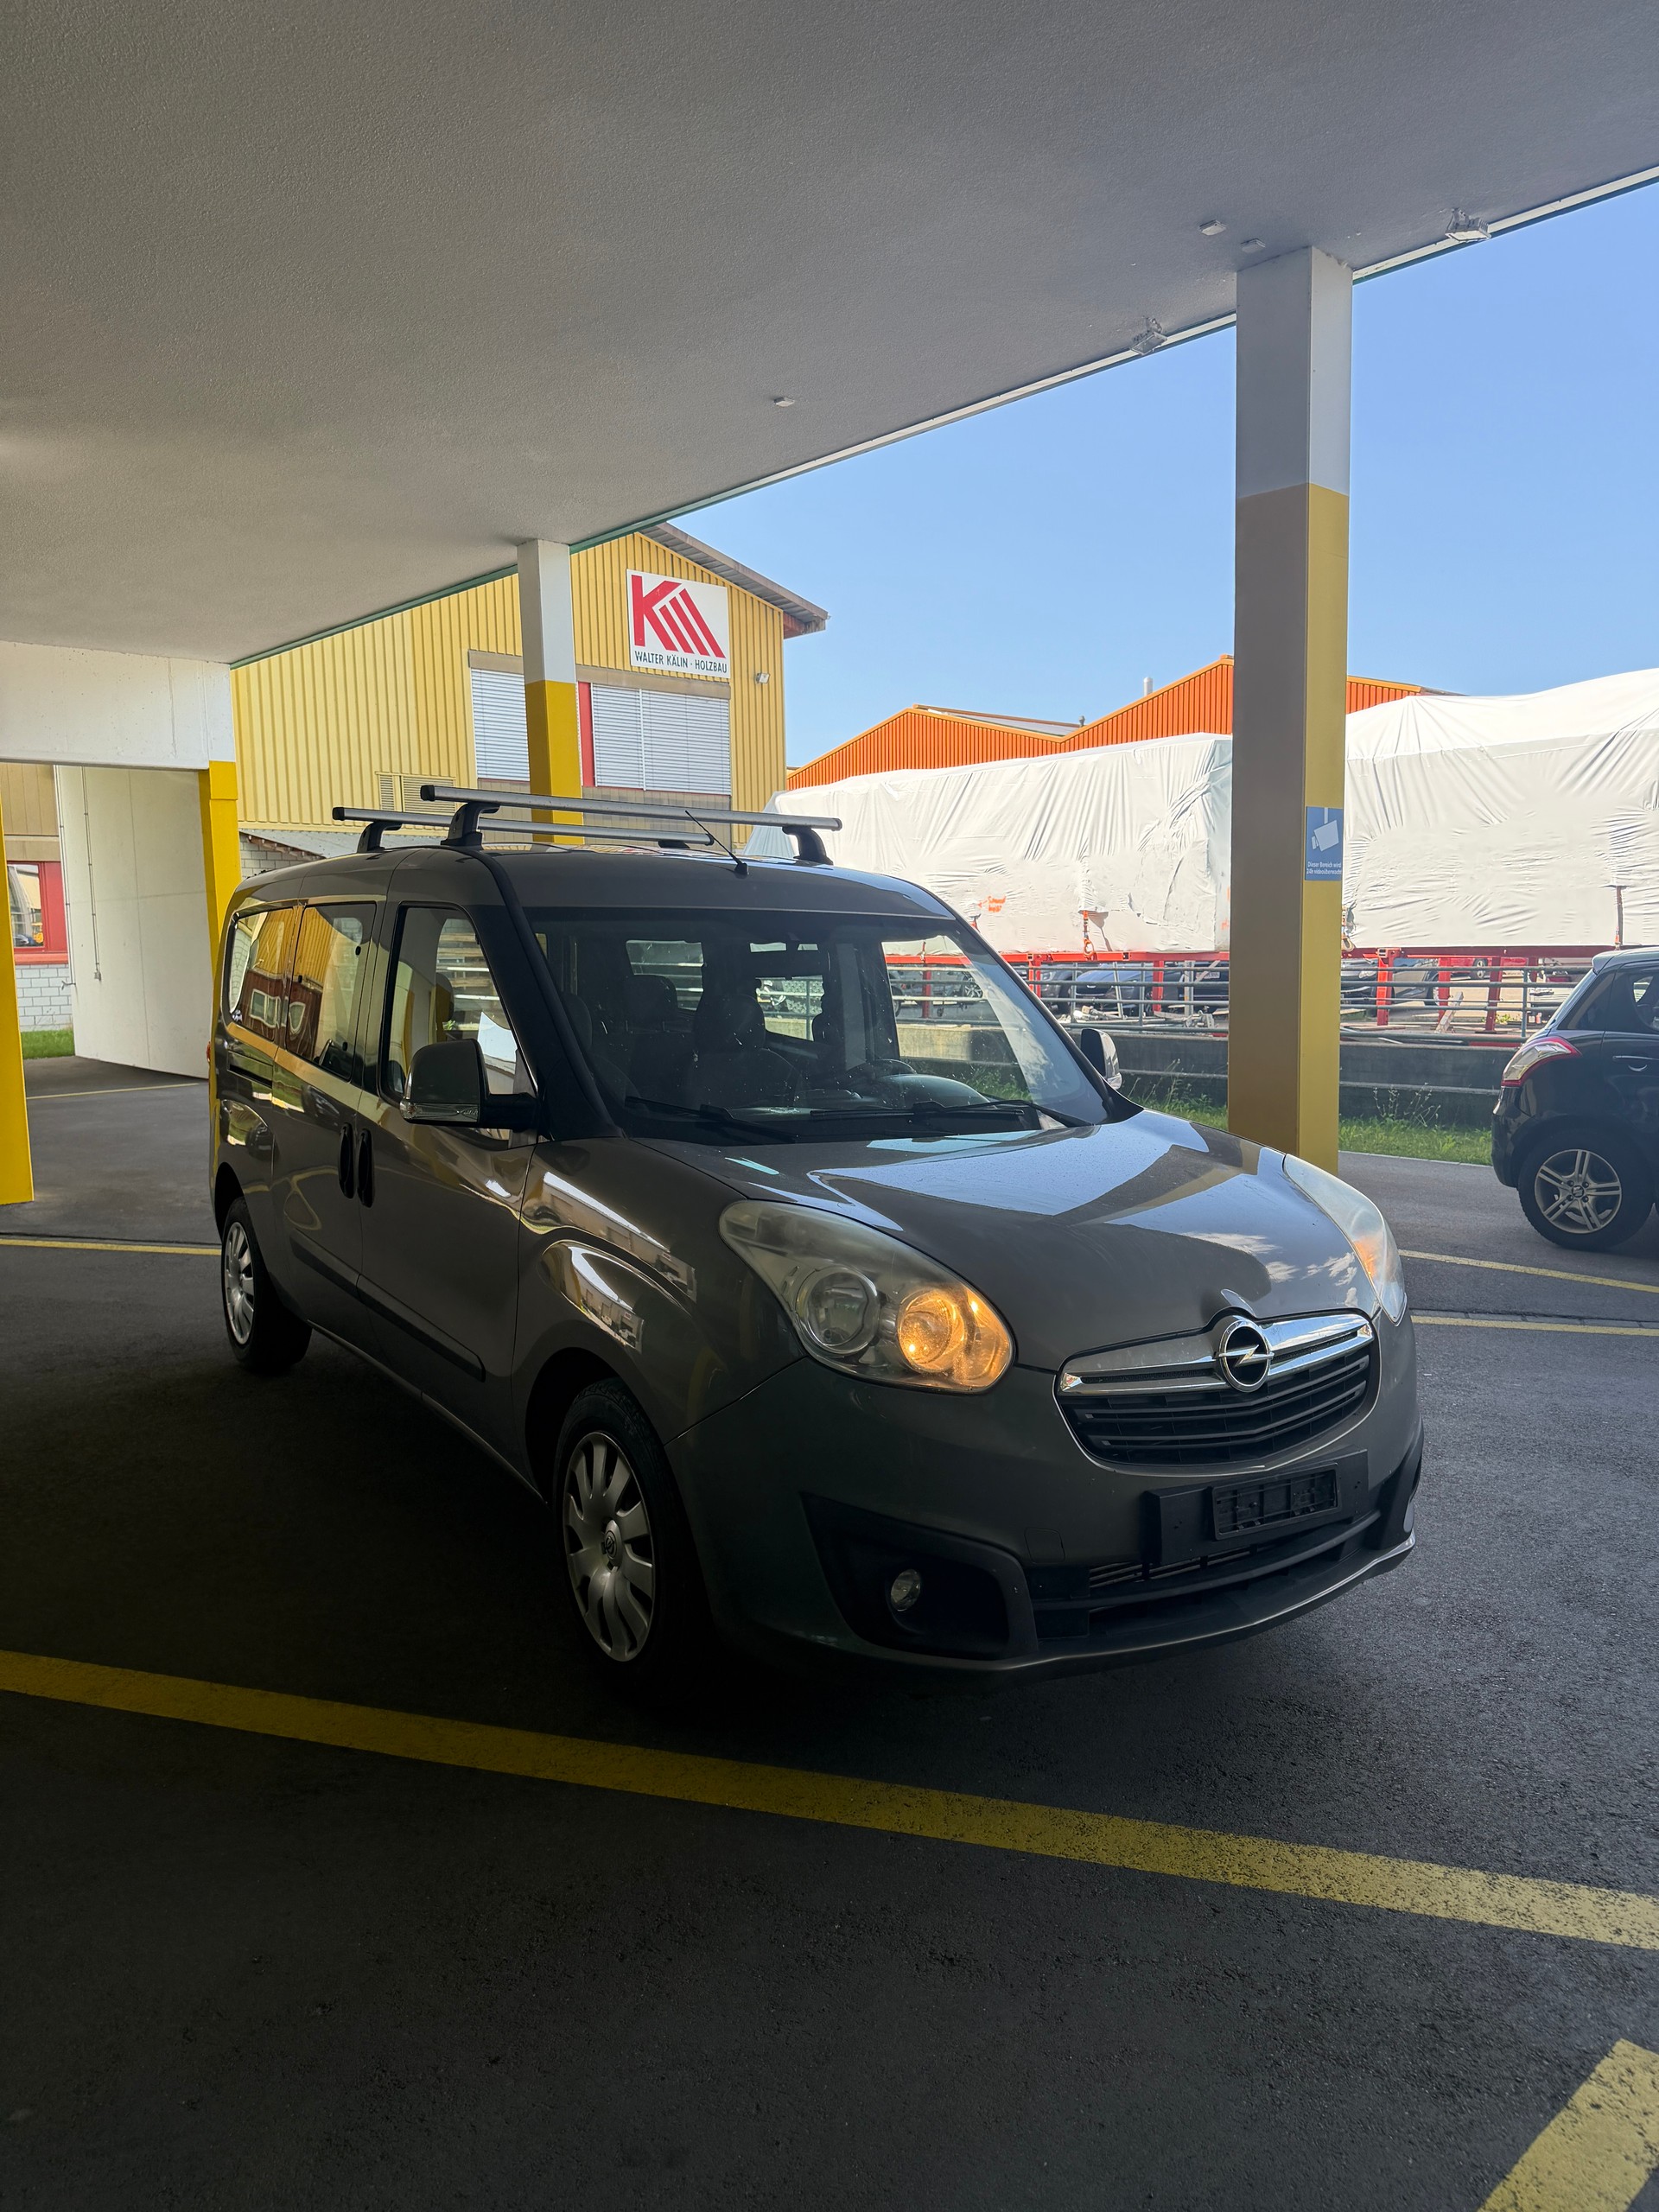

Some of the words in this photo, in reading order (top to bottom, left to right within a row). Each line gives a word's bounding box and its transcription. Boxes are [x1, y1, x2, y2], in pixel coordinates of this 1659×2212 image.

[634, 651, 664, 665] WALTER
[666, 654, 688, 668] KÄLIN
[695, 659, 728, 673] HOLZBAU
